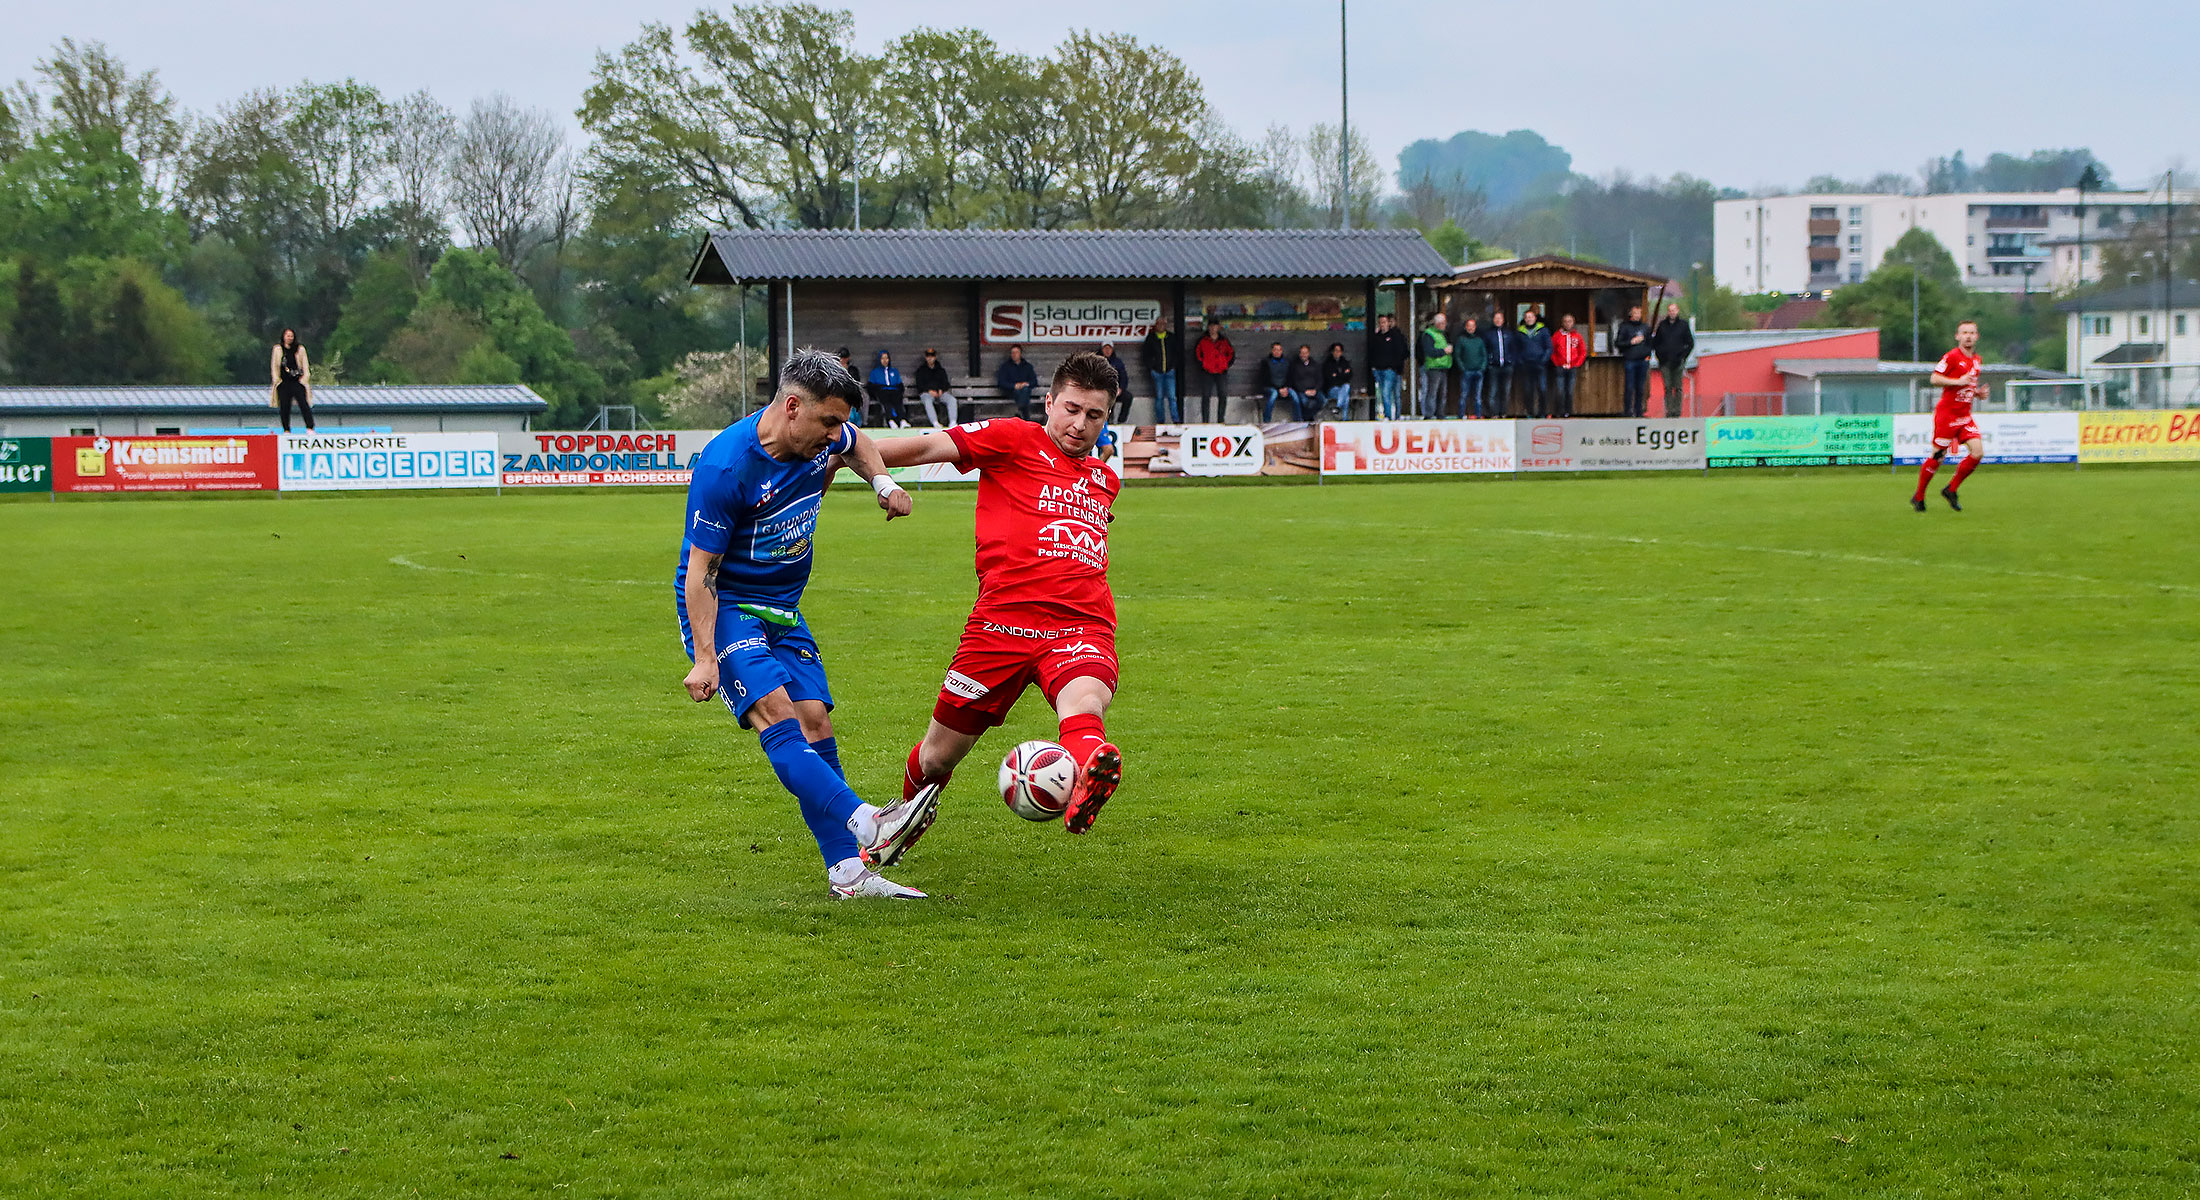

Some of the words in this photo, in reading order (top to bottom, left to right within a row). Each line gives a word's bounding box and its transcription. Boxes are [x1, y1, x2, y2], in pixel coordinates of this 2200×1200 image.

[1033, 305, 1157, 324] staudinger
[287, 437, 407, 450] TRANSPORTE
[535, 434, 676, 453] TOPDACH
[1580, 436, 1631, 446] Auohaus
[1636, 425, 1699, 450] Egger
[2081, 424, 2161, 445] ELEKTRO
[113, 438, 248, 465] Kremsmair
[1192, 436, 1253, 458] FOX
[284, 451, 495, 479] LANGEDER
[1521, 458, 1573, 468] SEAT
[505, 473, 590, 484] SPENGLEREI
[1046, 524, 1105, 557] TVM
[1038, 548, 1070, 558] Peter
[734, 679, 747, 697] 8
